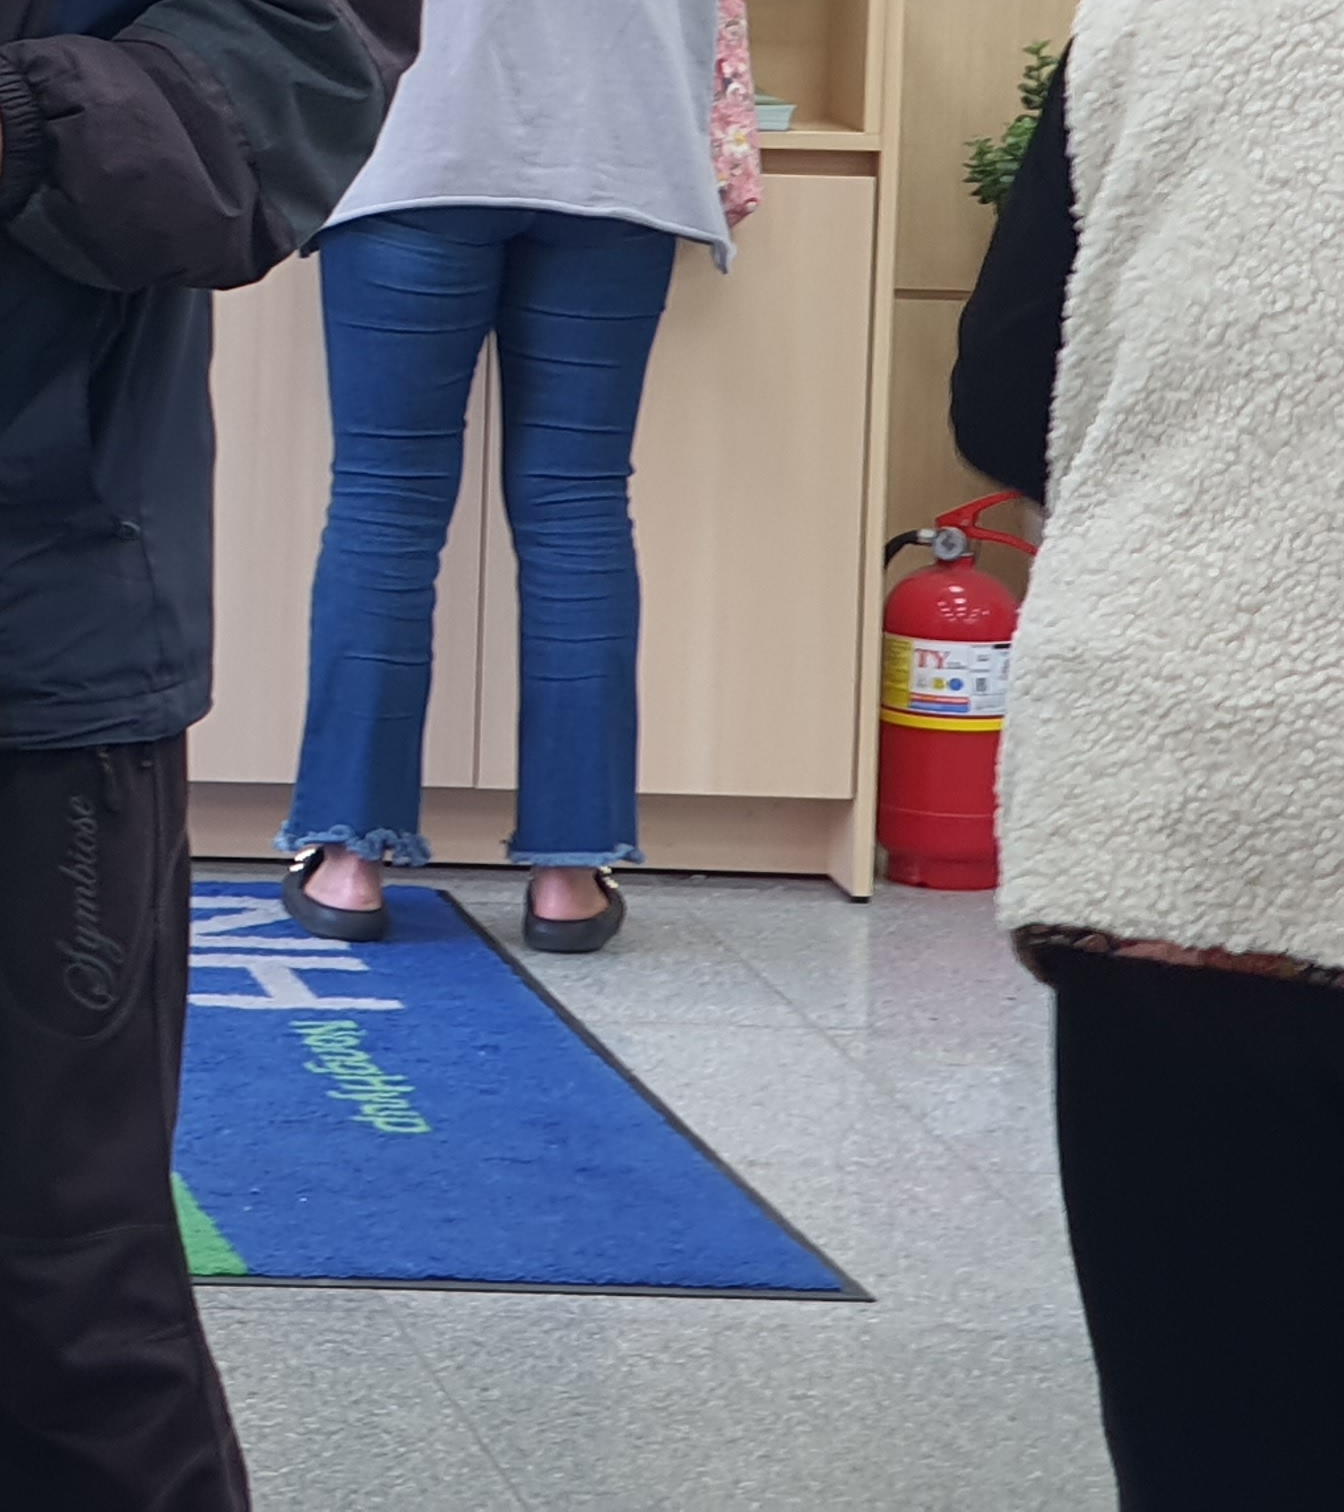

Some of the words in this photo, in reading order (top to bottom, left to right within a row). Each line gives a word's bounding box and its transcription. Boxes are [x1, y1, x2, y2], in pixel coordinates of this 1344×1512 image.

[914, 648, 952, 670] TY
[55, 795, 126, 1011] Symbiose
[288, 1019, 432, 1135] NongHyup
